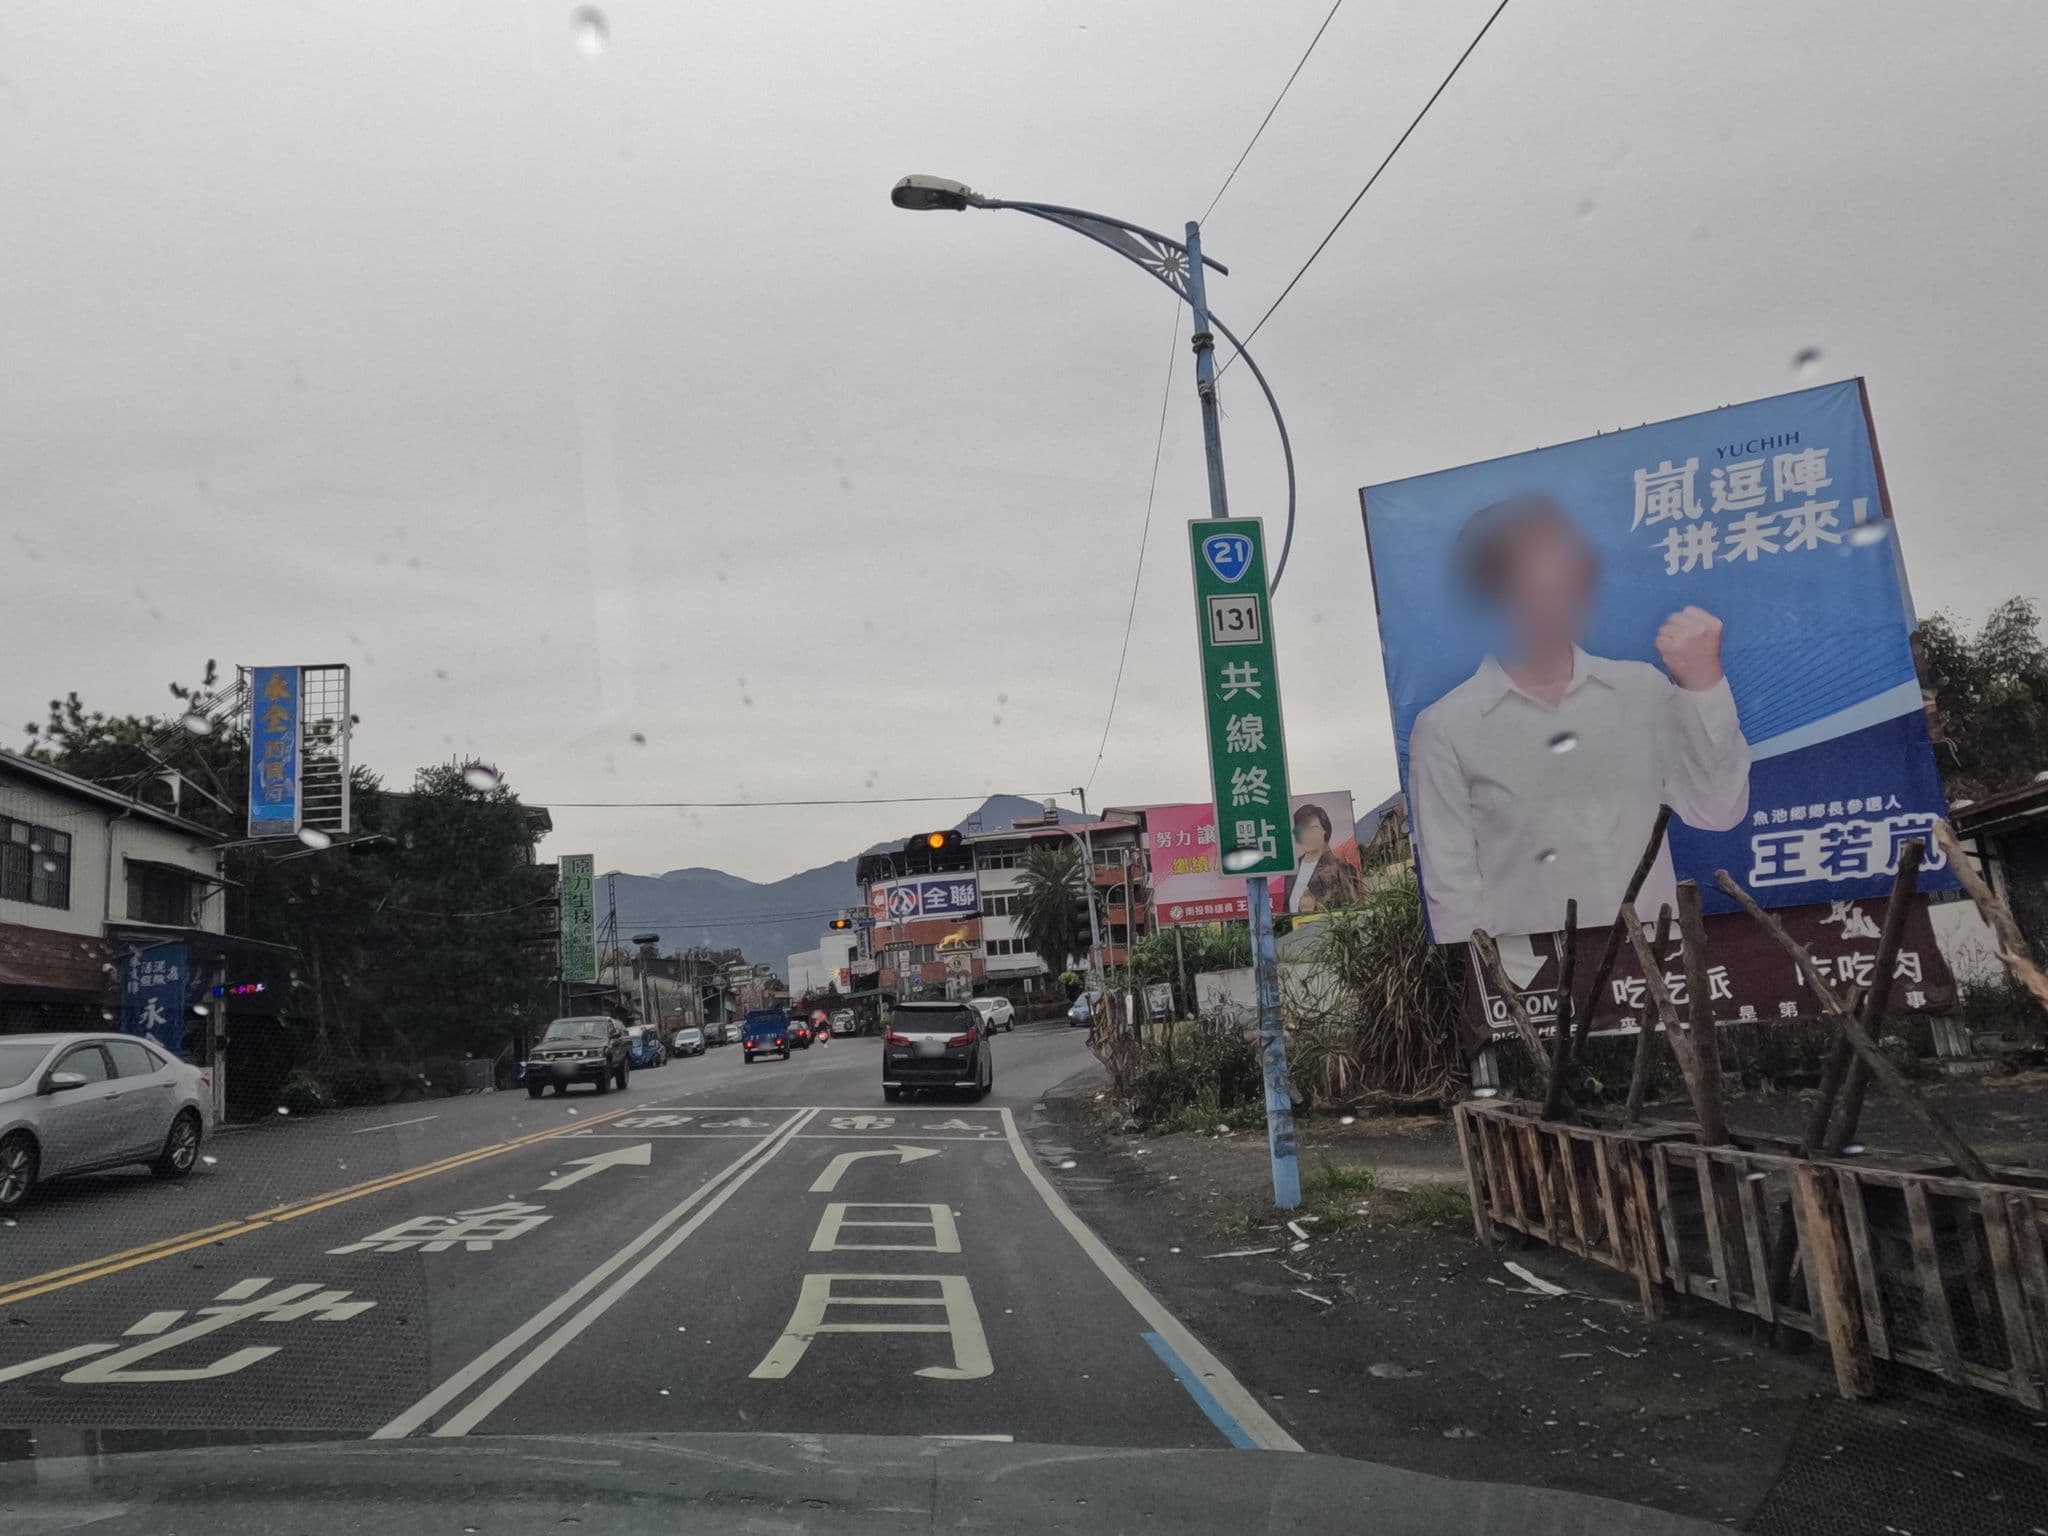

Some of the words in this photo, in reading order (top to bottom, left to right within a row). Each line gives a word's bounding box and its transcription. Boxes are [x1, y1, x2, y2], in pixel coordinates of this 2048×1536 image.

[1716, 431, 1801, 460] YUCHIH
[1630, 447, 1833, 532] 嵐逗陣
[1214, 541, 1244, 564] 21
[1215, 607, 1255, 631] 131
[1220, 660, 1277, 860] 共線終點
[1752, 793, 1903, 827] 魚池鄉鄉長參選人
[1172, 855, 1220, 875] 繼續
[923, 883, 976, 910] 全聯
